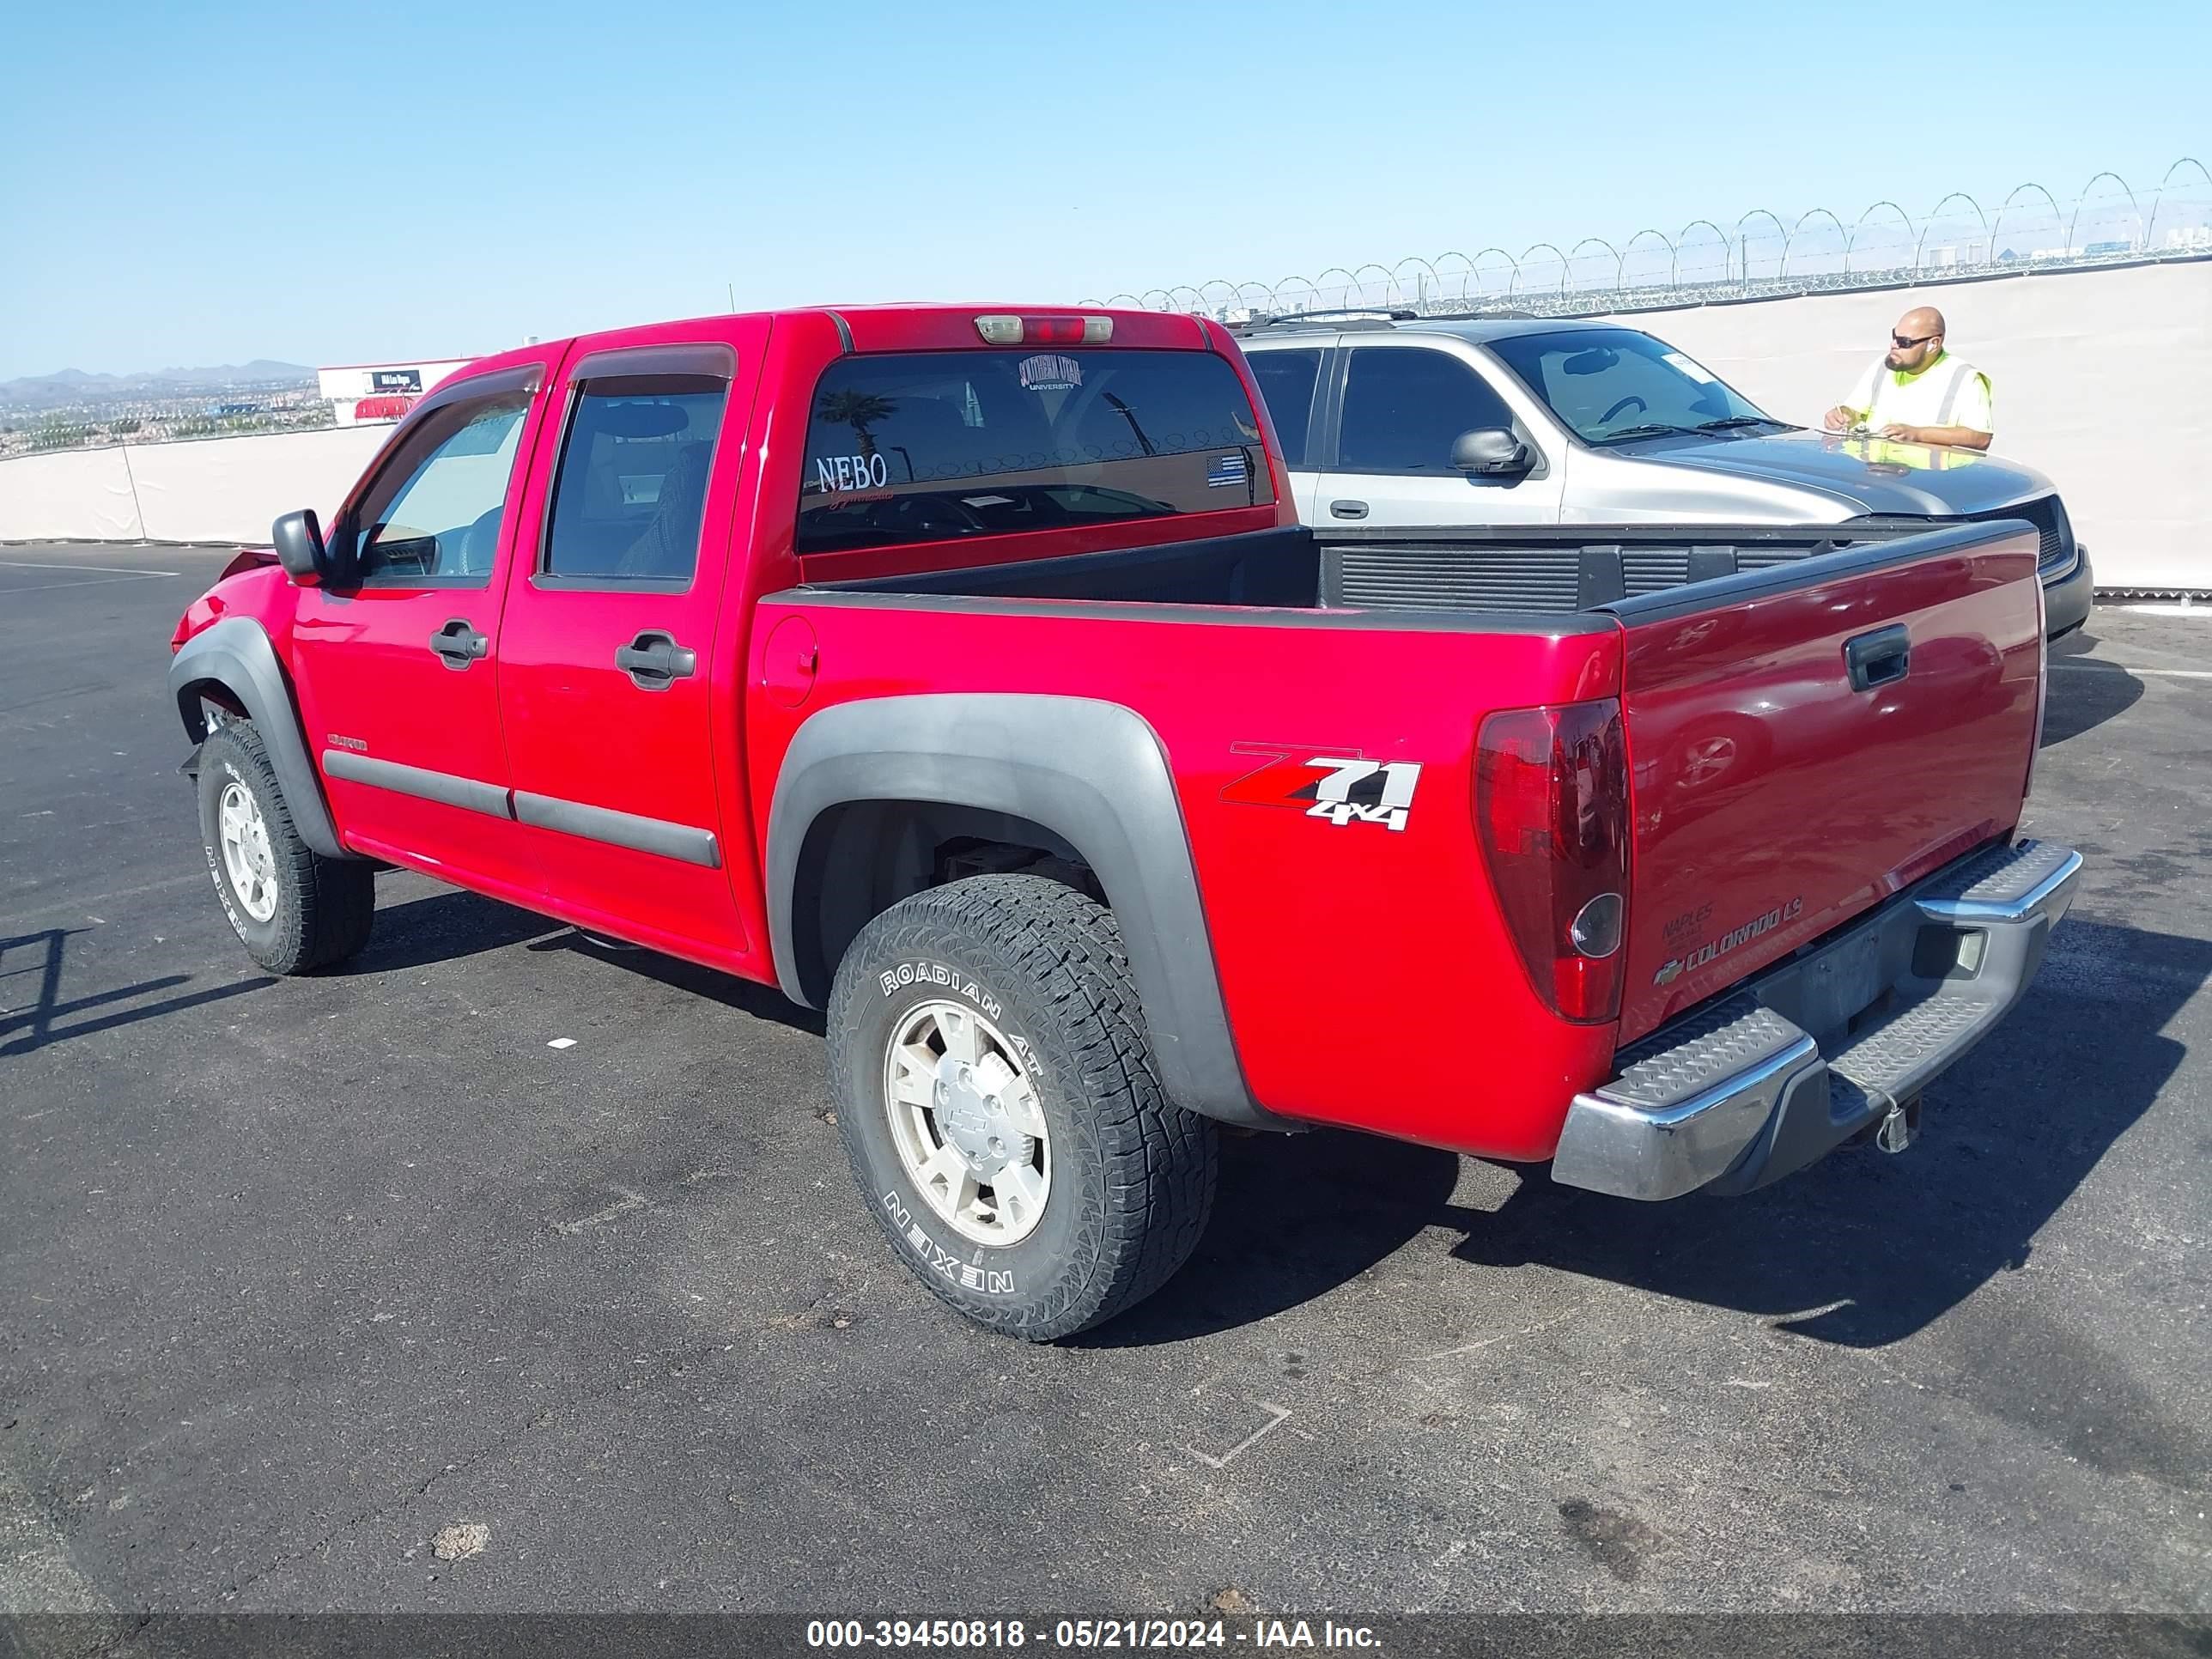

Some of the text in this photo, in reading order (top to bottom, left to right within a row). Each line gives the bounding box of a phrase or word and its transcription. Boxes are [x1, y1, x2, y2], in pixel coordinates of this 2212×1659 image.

[1018, 355, 1083, 387] SOUTHERN UTAH
[817, 453, 886, 492] NEBO
[1218, 740, 1424, 811] Z71
[1686, 908, 1781, 972] COLORADO
[1783, 896, 1802, 922] LS
[879, 963, 1043, 1076] ROADIAN AT
[883, 1190, 1015, 1294] NEXEN
